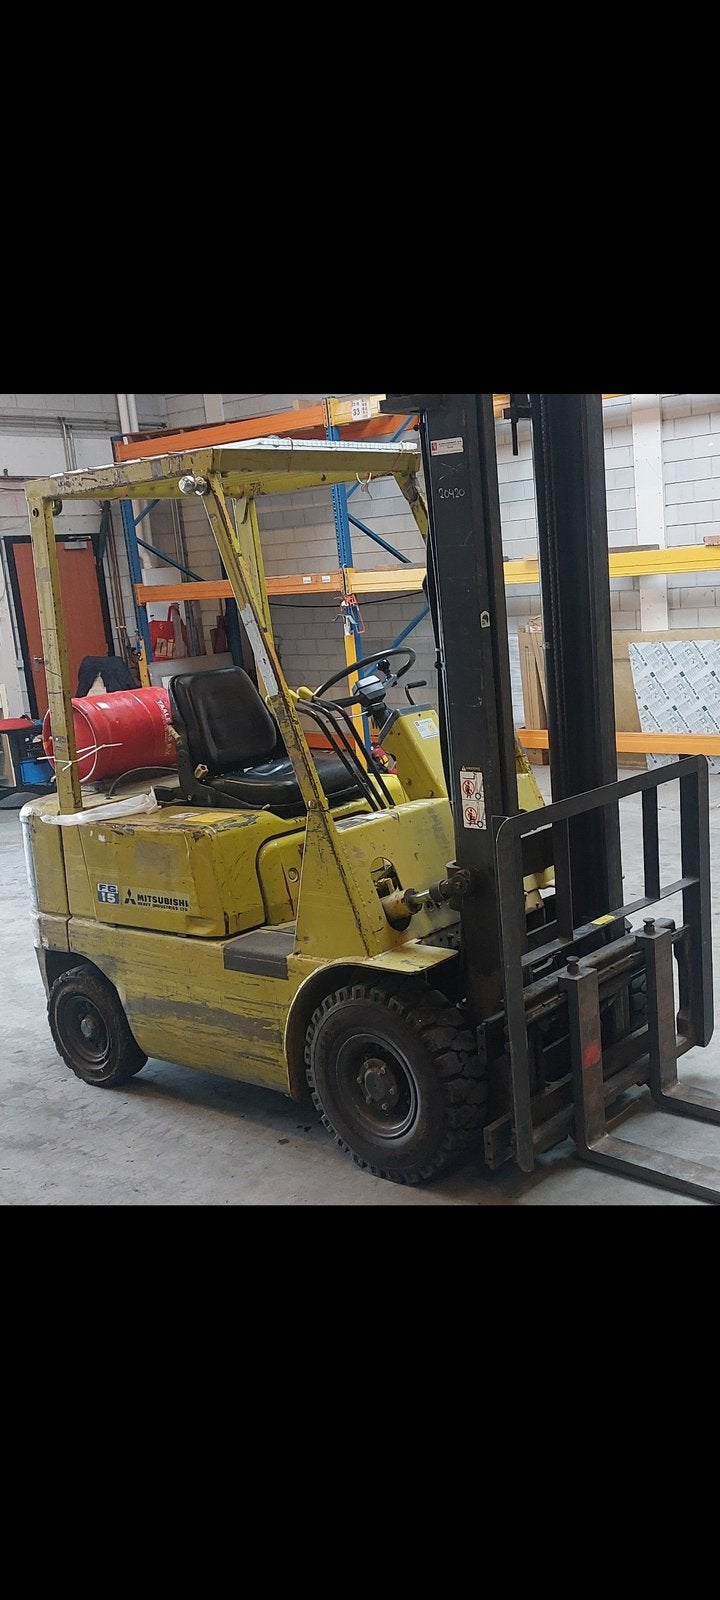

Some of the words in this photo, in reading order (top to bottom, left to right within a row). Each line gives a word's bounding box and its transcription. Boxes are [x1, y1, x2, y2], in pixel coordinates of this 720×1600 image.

[438, 487, 465, 499] 20420
[101, 892, 116, 902] 15
[137, 894, 188, 907] MITSUBISHI
